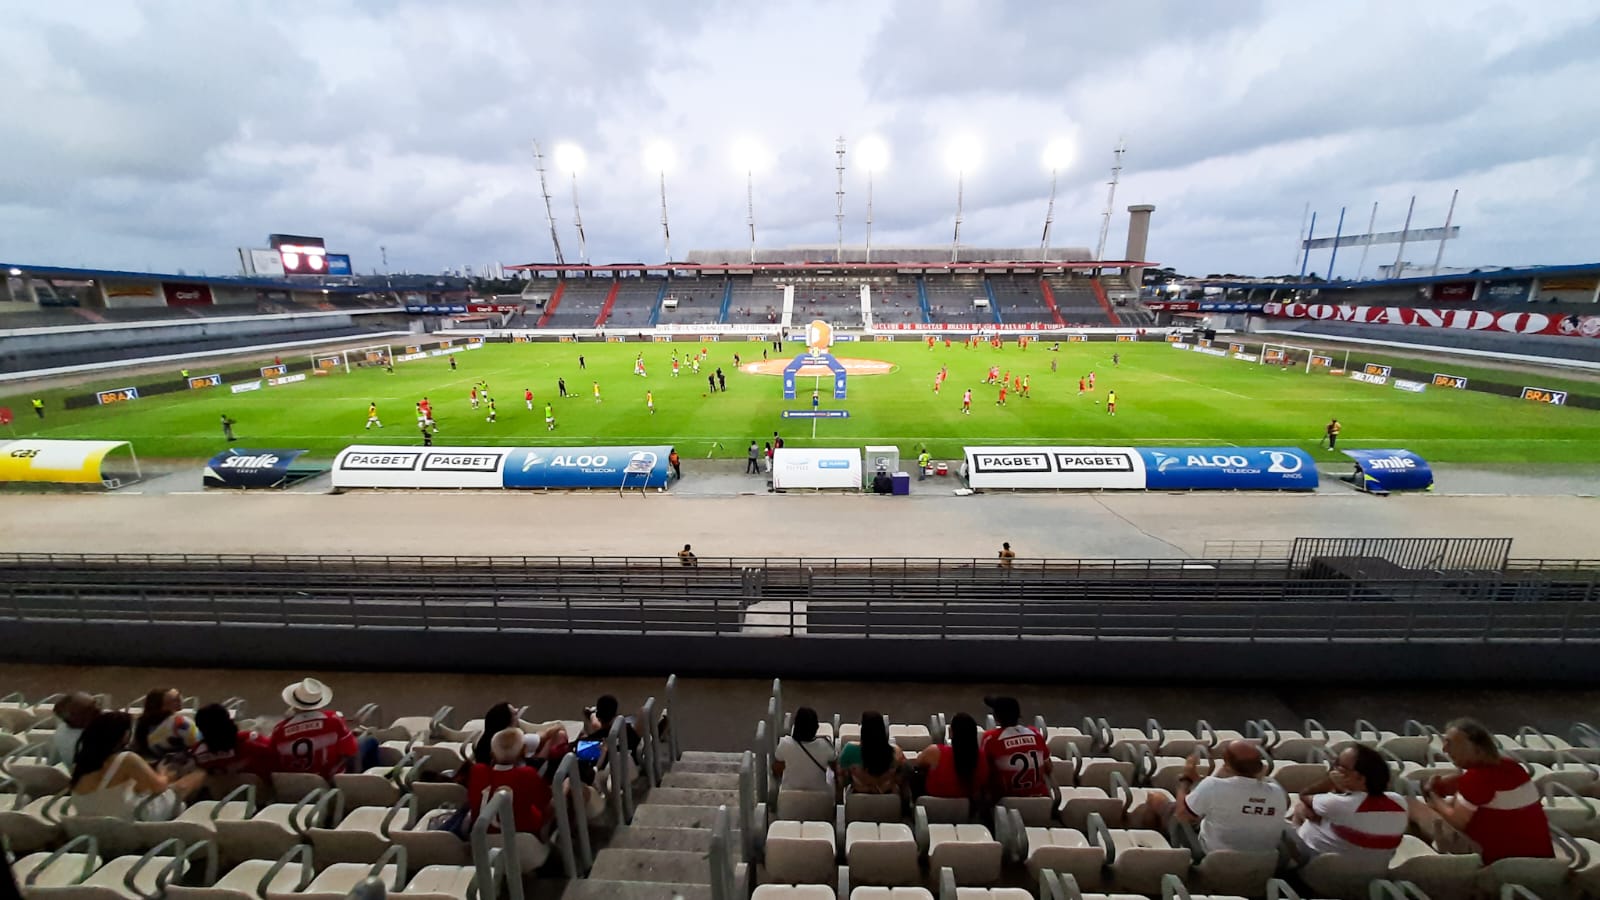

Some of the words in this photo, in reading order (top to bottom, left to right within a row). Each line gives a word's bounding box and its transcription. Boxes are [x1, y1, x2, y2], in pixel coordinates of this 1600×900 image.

[1285, 302, 1549, 334] COMANDO
[1435, 376, 1464, 389] BRAX
[101, 389, 136, 404] BRAX
[1525, 390, 1562, 405] BRAX
[220, 453, 279, 468] smile
[350, 456, 411, 465] PAGBET
[431, 456, 491, 466] PAGBET
[550, 455, 609, 467] ALOO
[983, 457, 1041, 466] PAGBET
[1064, 457, 1122, 466] PAGBET
[1187, 455, 1248, 468] ALOO
[1368, 455, 1416, 469] smile
[292, 738, 313, 770] 9
[1010, 750, 1039, 788] 21
